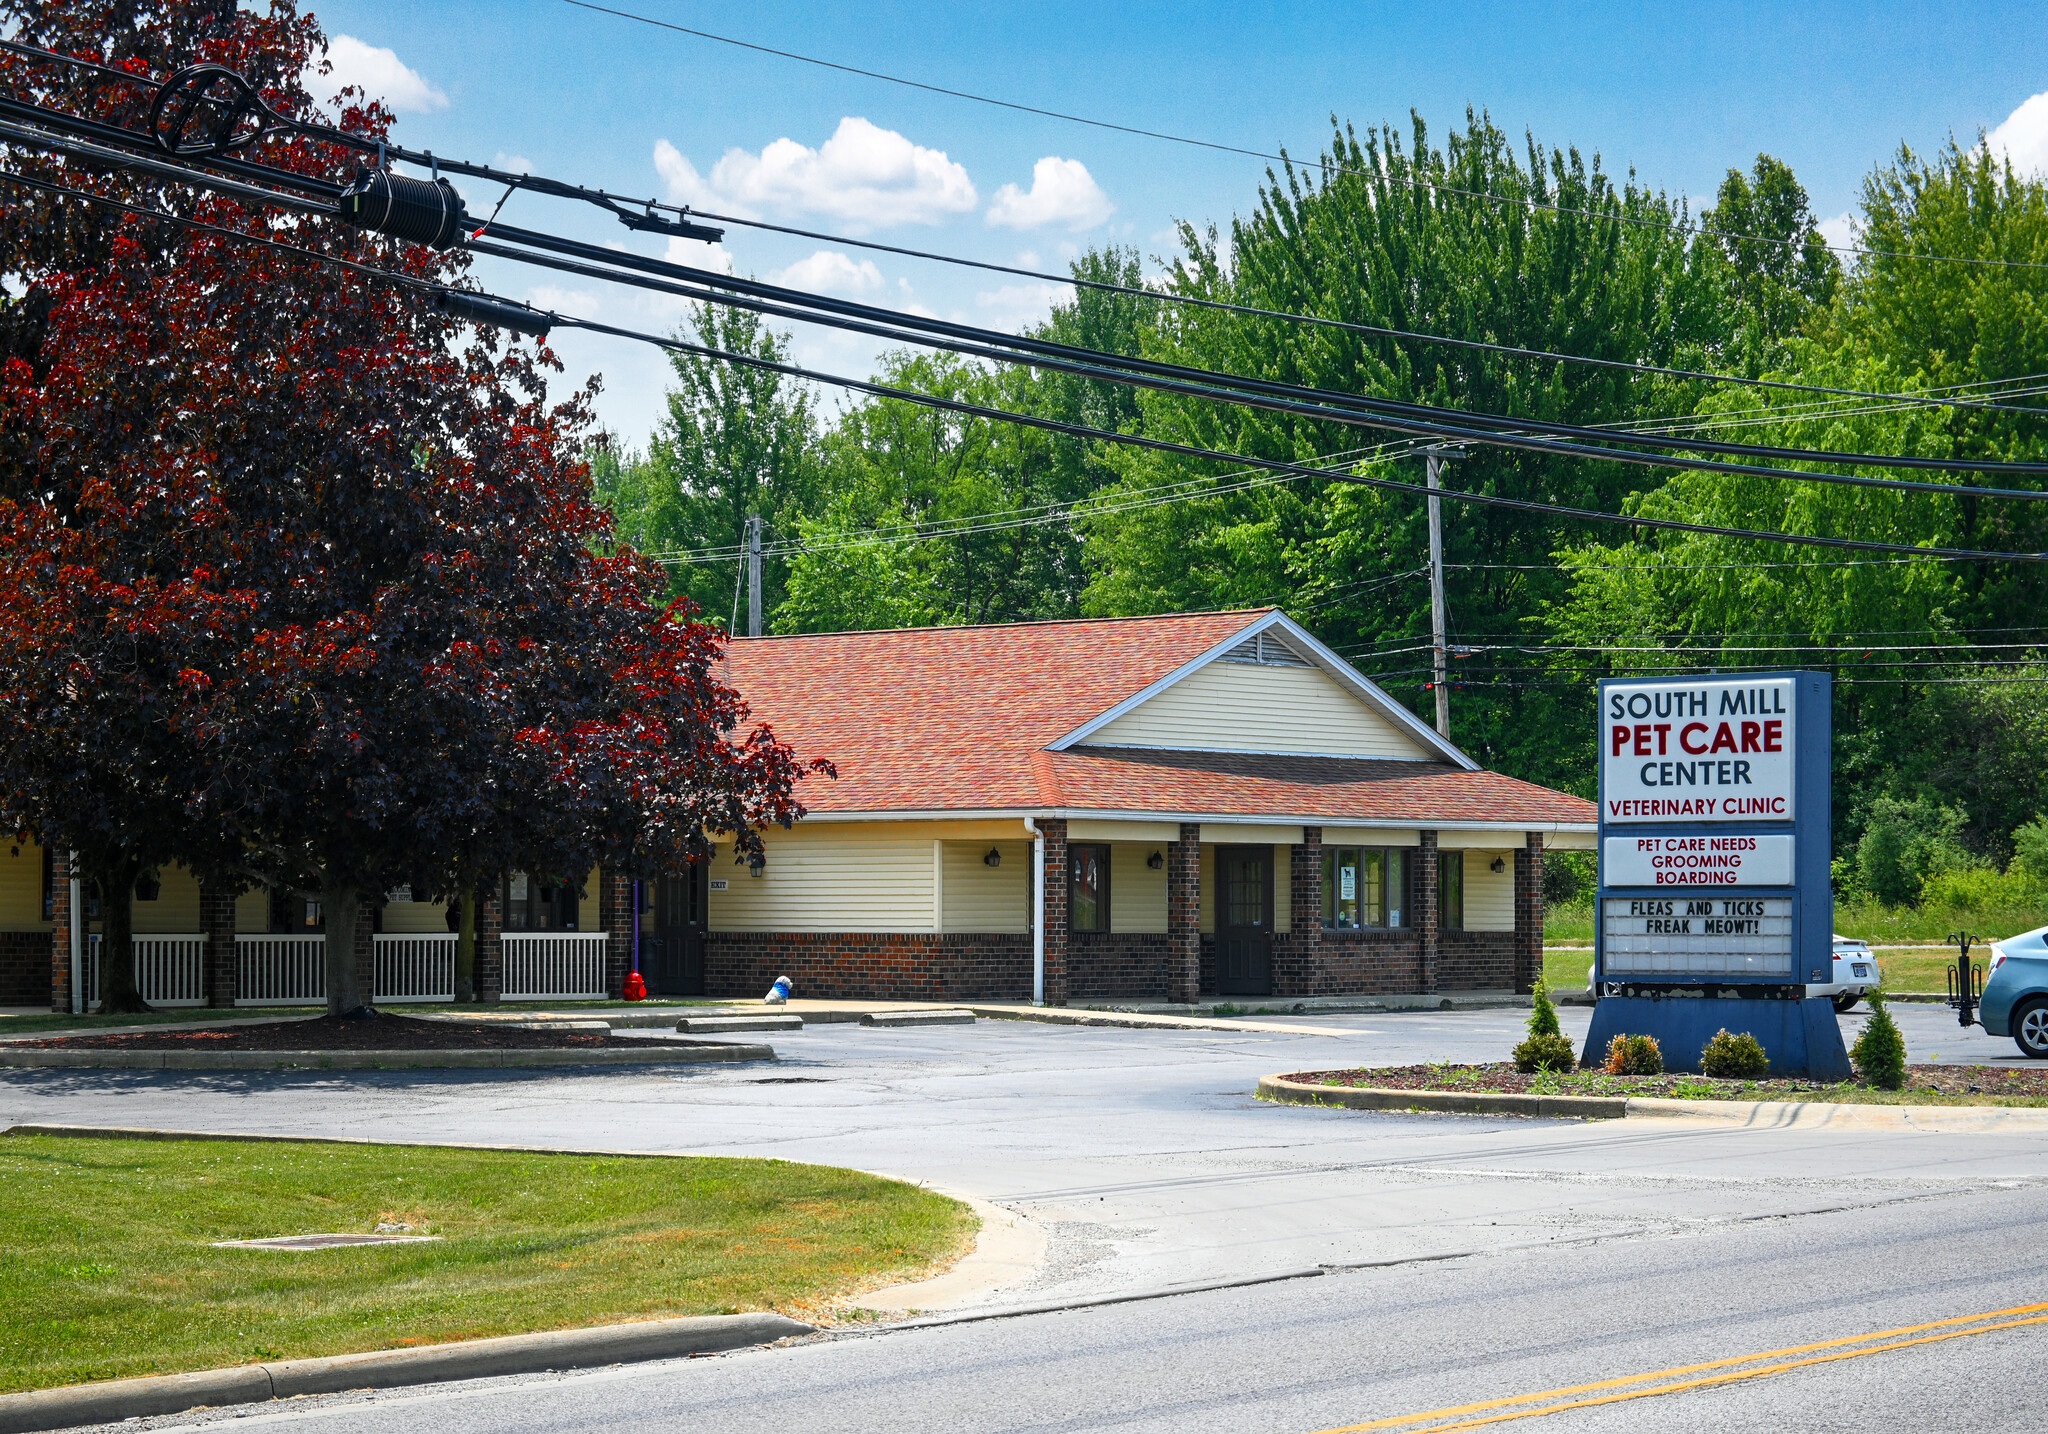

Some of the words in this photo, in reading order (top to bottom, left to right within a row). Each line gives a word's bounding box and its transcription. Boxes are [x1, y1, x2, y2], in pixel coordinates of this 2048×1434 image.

[1610, 692, 1708, 720] SOUTH
[1720, 688, 1786, 715] MILL
[1612, 724, 1672, 757] PET
[1680, 720, 1783, 754] CARE
[1640, 760, 1752, 787] CENTER
[1609, 798, 1717, 816] VETERINARY
[1723, 797, 1786, 814] CLINIC
[1638, 839, 1662, 852] PET
[1666, 839, 1705, 851] CARE
[1710, 838, 1757, 851] NEEDS
[1651, 855, 1742, 868] GROOMING
[1656, 872, 1737, 884] BOARDING
[1631, 902, 1673, 915] FLEAS
[1687, 902, 1712, 915] AND
[1724, 902, 1764, 915] TICKS
[1646, 920, 1690, 933] FREAK
[1705, 919, 1759, 934] MEOWT!
